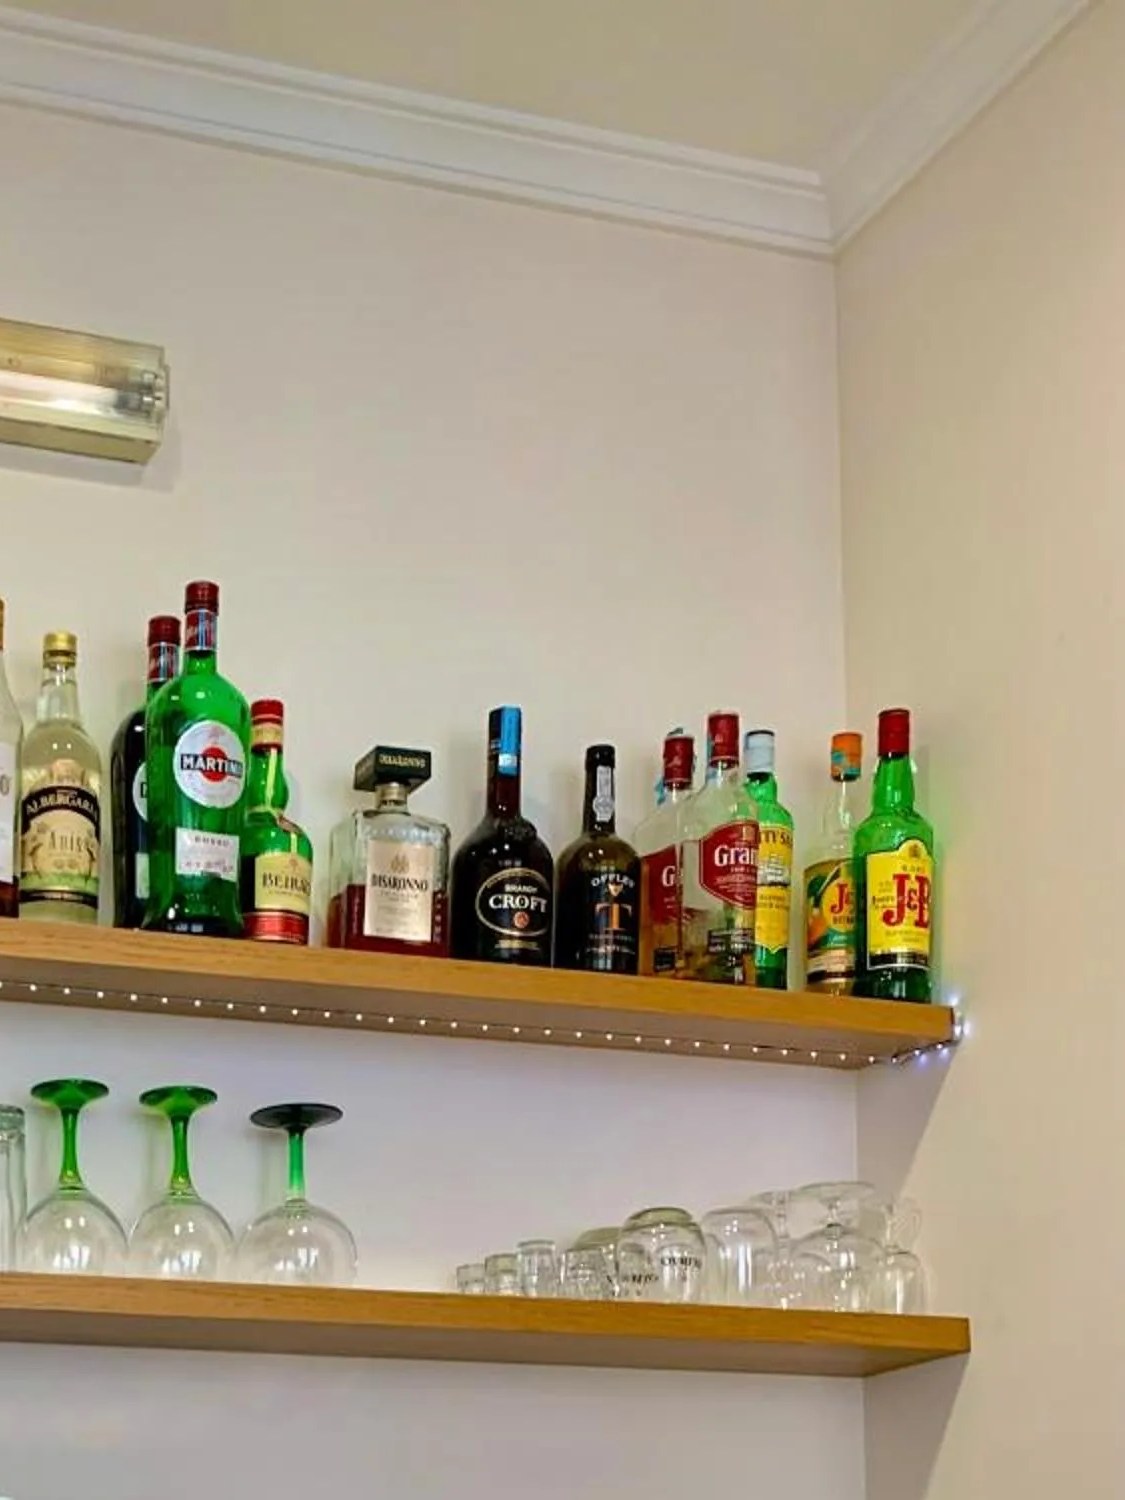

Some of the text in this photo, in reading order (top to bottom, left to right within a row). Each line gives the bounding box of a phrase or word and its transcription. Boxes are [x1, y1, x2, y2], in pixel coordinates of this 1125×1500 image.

[181, 754, 242, 778] MARTINI
[372, 873, 429, 891] DISARONNO
[488, 893, 548, 913] CROFT
